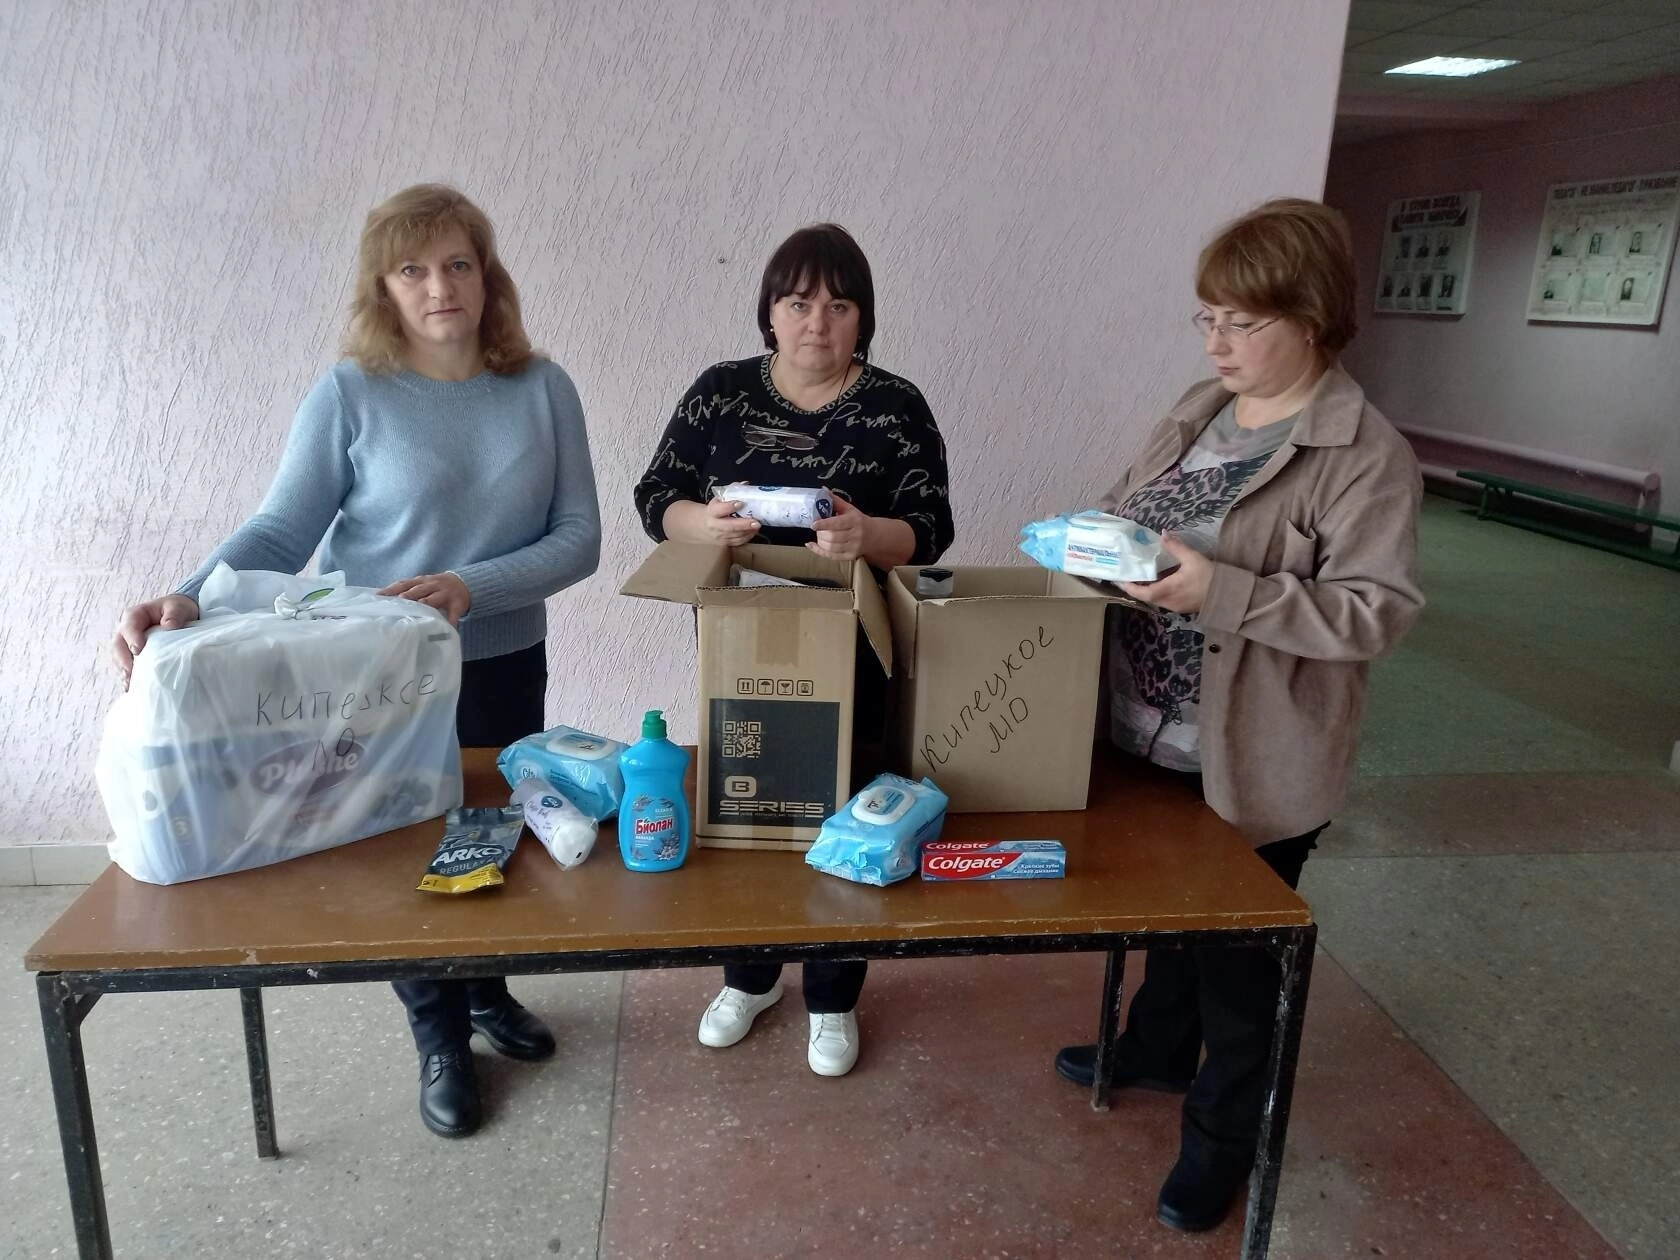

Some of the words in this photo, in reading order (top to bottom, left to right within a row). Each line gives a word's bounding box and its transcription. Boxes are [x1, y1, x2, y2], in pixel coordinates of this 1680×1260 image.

[719, 799, 825, 819] SERIES
[634, 817, 674, 835] Биолан
[925, 841, 990, 850] Colgate
[431, 846, 503, 867] ARKO
[928, 855, 1003, 873] Colgate
[439, 860, 483, 875] REGULA
